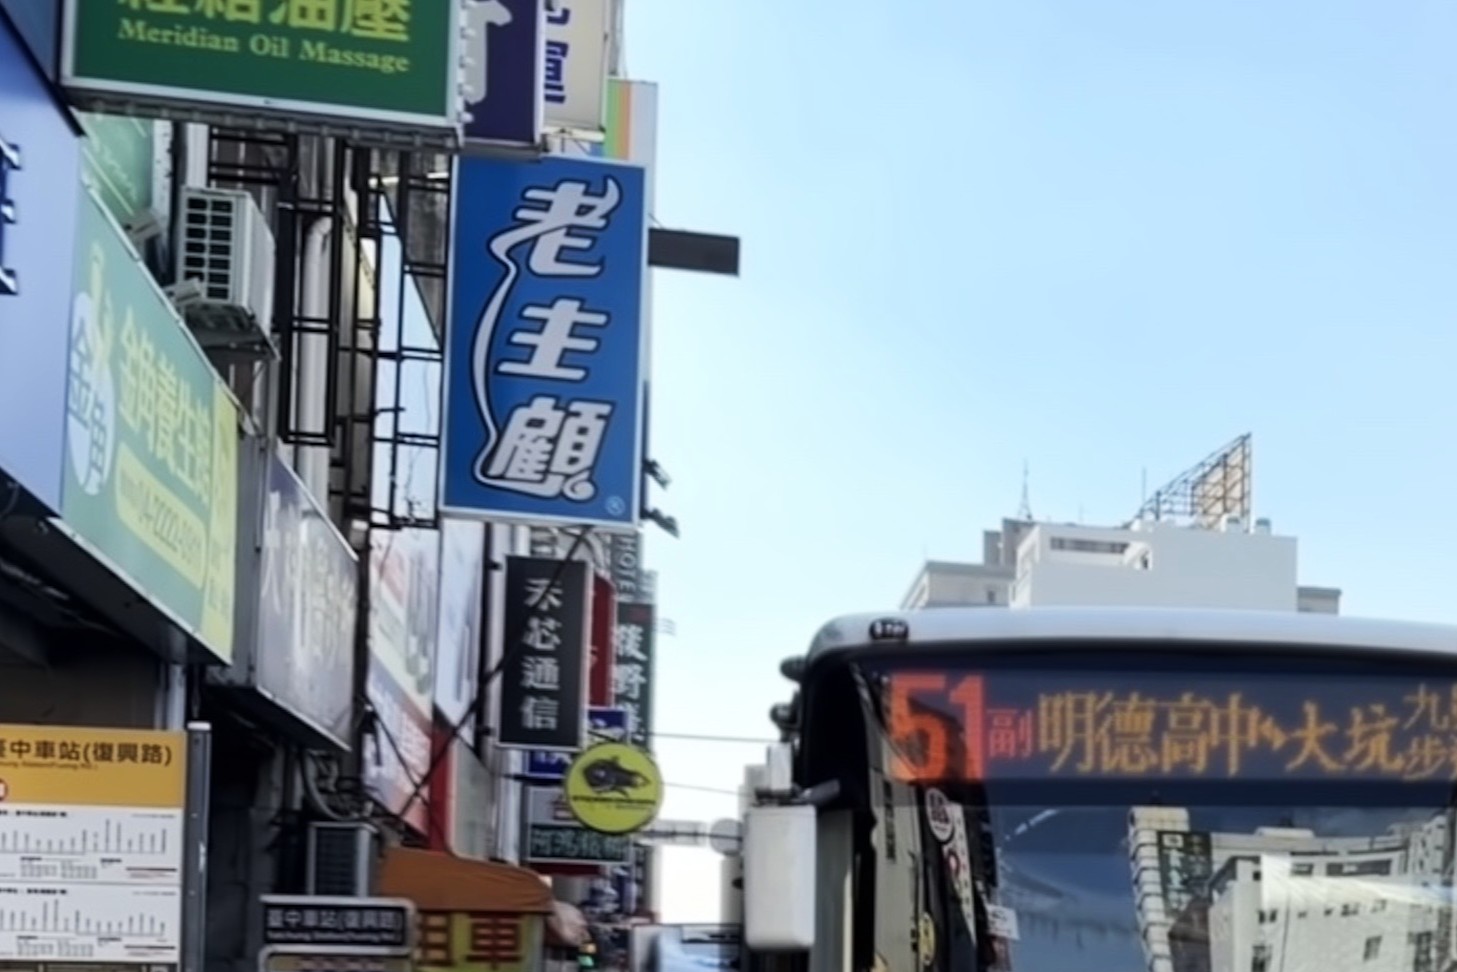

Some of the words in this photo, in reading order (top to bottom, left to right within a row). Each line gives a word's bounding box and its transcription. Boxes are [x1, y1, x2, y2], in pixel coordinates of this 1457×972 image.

[117, 18, 240, 53] Meridian
[249, 35, 290, 59] Oil
[299, 39, 411, 74] Massage
[475, 176, 622, 501] 老主顧
[888, 673, 986, 782] 51
[1038, 688, 1260, 776] 明德高中
[1287, 702, 1403, 773] 大坑
